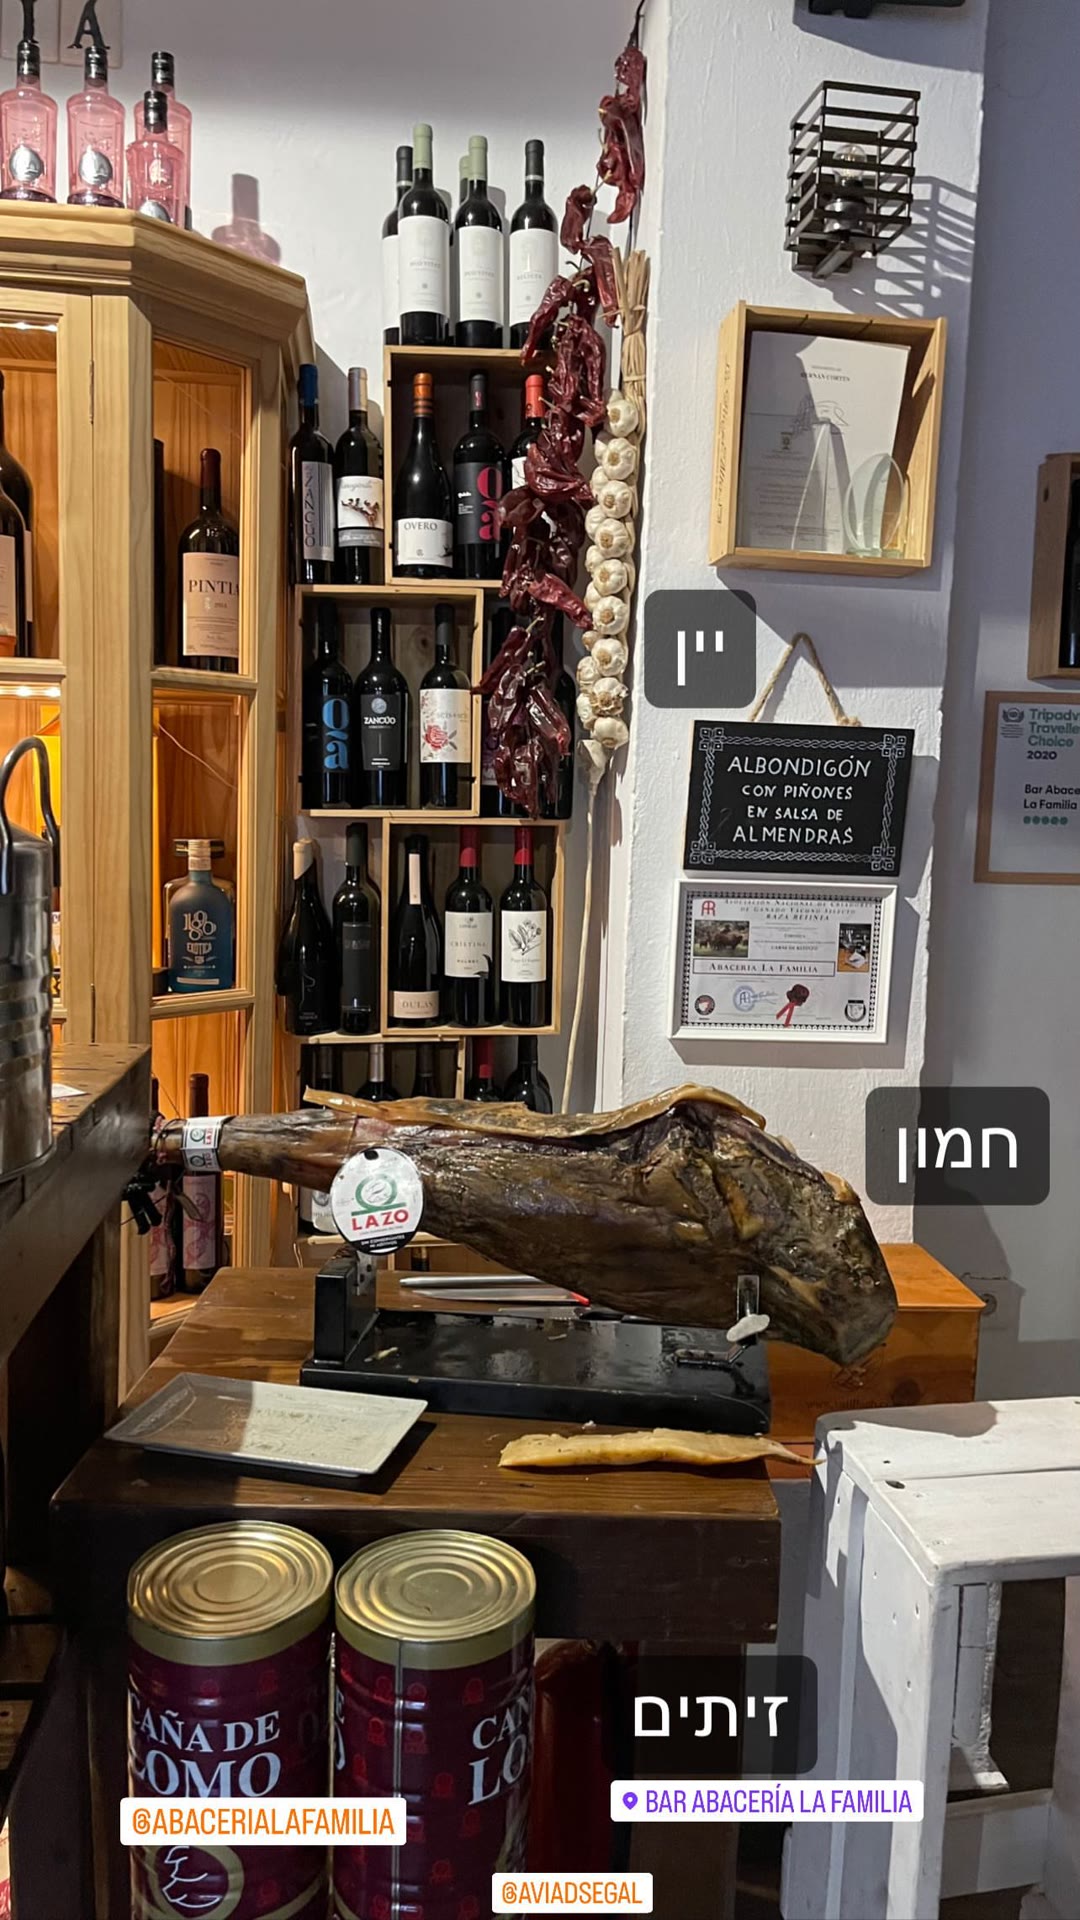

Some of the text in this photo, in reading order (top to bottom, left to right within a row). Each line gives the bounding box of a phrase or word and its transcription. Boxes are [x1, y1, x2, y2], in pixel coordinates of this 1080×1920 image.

[404, 521, 438, 532] OVERO
[1028, 735, 1074, 748] Choice
[1026, 750, 1058, 760] 2020
[727, 755, 871, 778] ALBONDIGÓN
[741, 782, 853, 800] CON PIÑONES
[1024, 783, 1043, 794] Bar
[1023, 798, 1078, 810] La Familia
[747, 805, 844, 822] EN SALSA DE
[732, 825, 854, 846] ALMENDRAS
[351, 1209, 409, 1231] LAZO
[223, 1710, 280, 1752] DE
